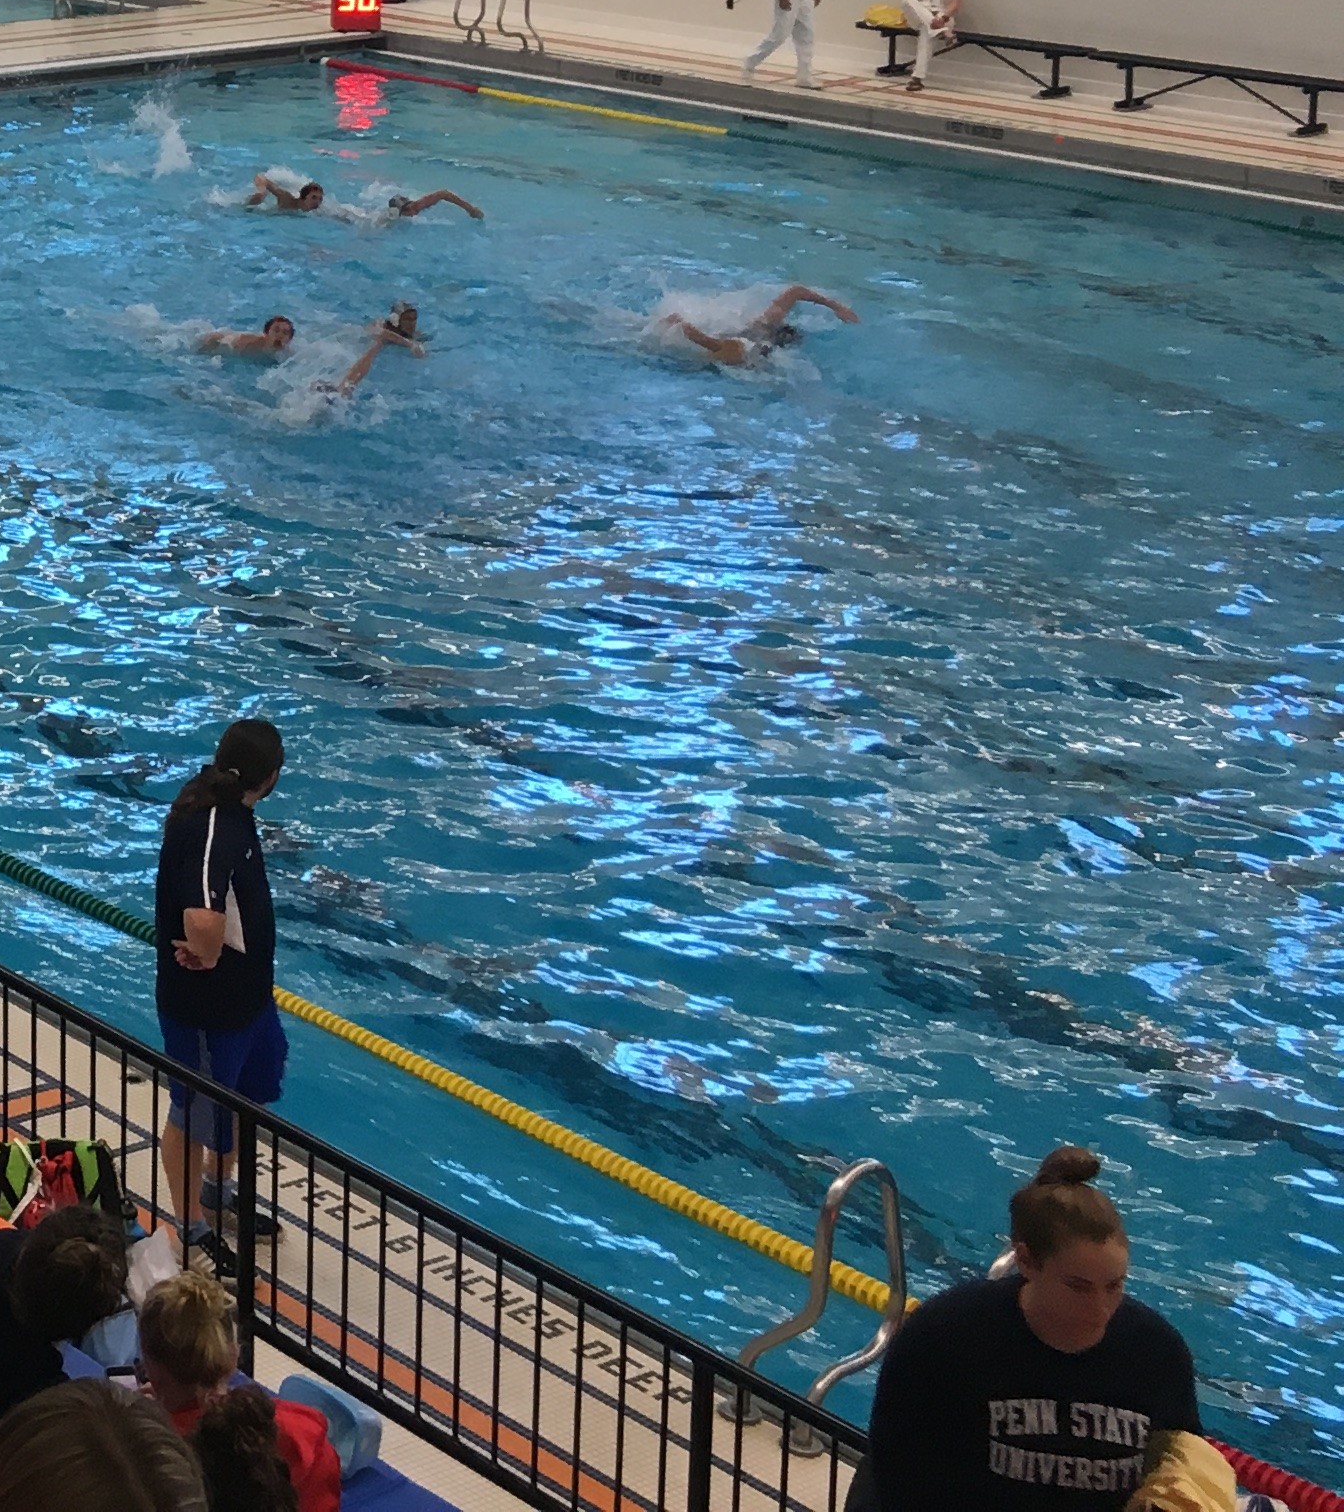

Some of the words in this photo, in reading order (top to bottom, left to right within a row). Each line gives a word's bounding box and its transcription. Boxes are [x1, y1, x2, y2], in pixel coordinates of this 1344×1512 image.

[279, 1176, 390, 1231] FEET
[421, 1254, 576, 1340] INCHES
[570, 1339, 693, 1405] DEEP
[988, 1398, 1059, 1437] PENN
[1069, 1402, 1152, 1449] STATE
[988, 1438, 1145, 1491] UNIVERSITY
